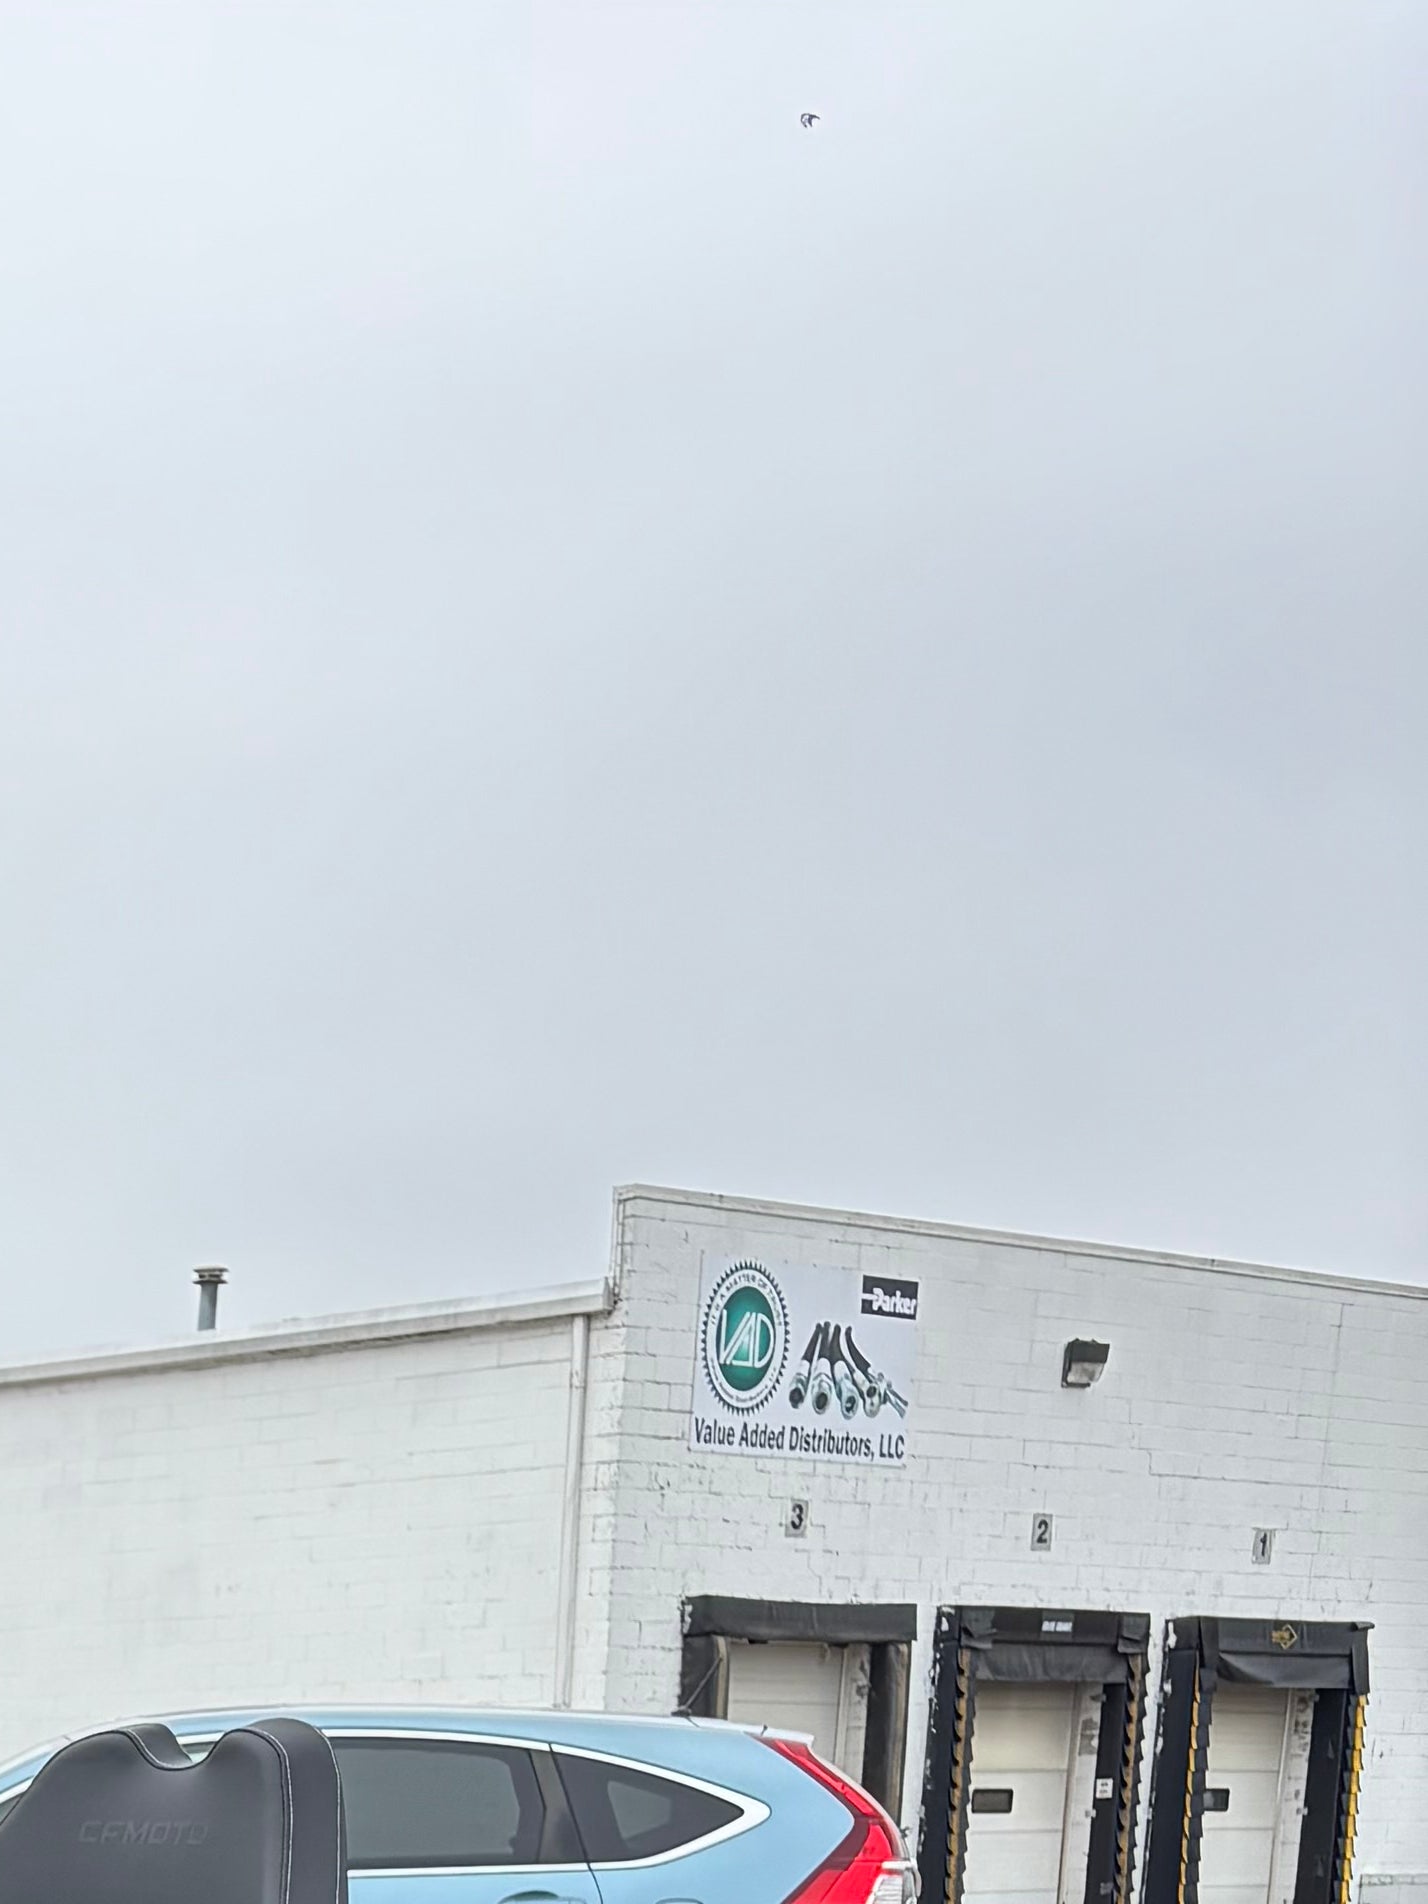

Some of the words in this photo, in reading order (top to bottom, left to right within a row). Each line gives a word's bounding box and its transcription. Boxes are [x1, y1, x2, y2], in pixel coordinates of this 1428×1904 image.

[872, 1287, 916, 1315] Parker
[694, 1417, 735, 1446] Value
[739, 1421, 785, 1450] Added
[789, 1426, 874, 1461] Distributors,
[879, 1434, 904, 1459] LLC
[789, 1503, 805, 1531] 3
[1035, 1518, 1050, 1545] 2
[1258, 1531, 1270, 1559] 1
[78, 1820, 210, 1846] CFMOTO
